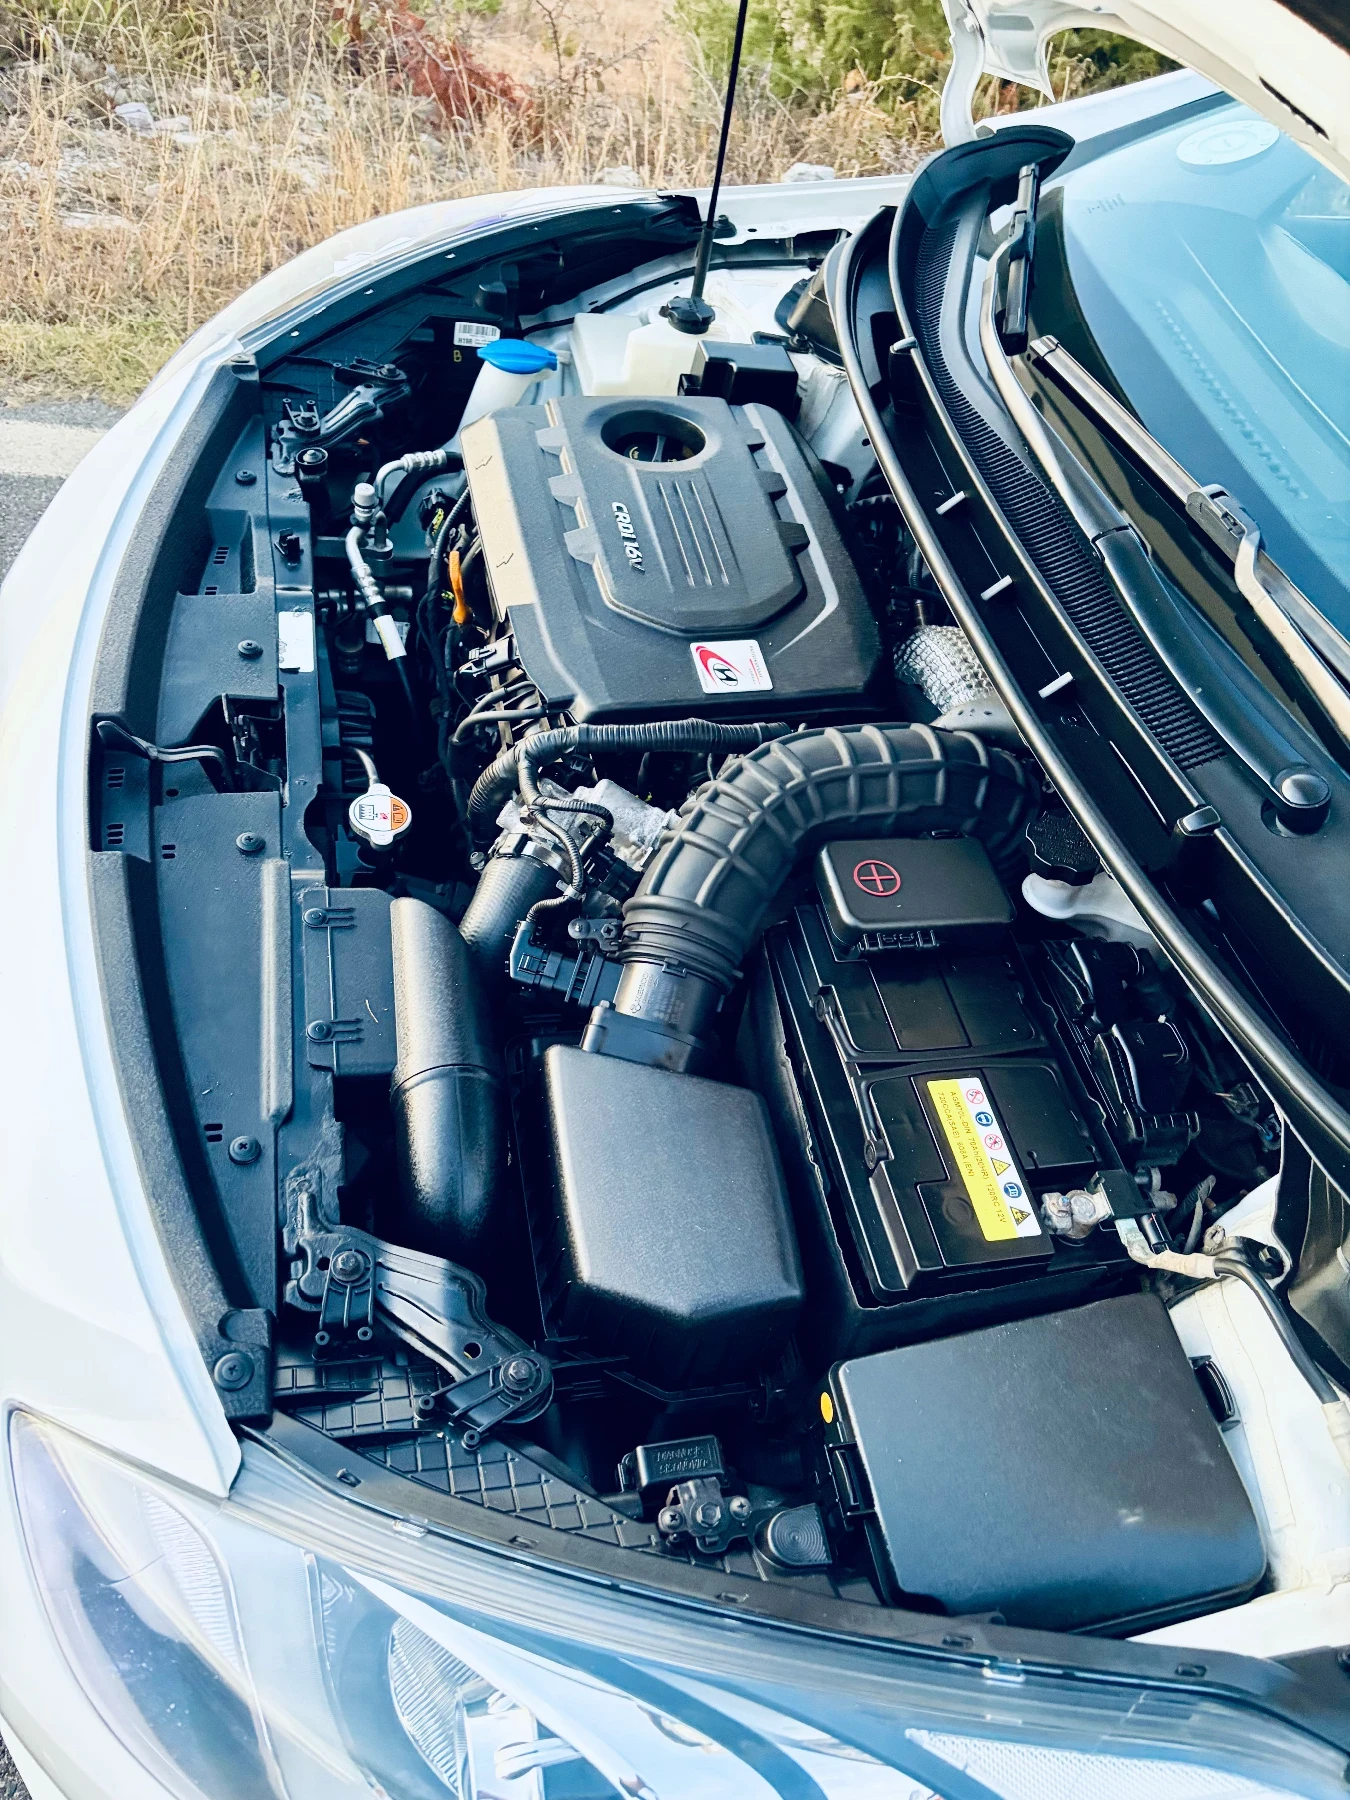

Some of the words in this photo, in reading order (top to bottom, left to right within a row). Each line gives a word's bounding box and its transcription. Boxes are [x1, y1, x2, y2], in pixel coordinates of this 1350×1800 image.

[453, 349, 462, 362] B
[623, 540, 645, 573] 16V
[949, 1091, 971, 1134] AGM70L-DIN
[986, 1183, 1001, 1207] 120RC
[996, 1208, 1007, 1224] 12V
